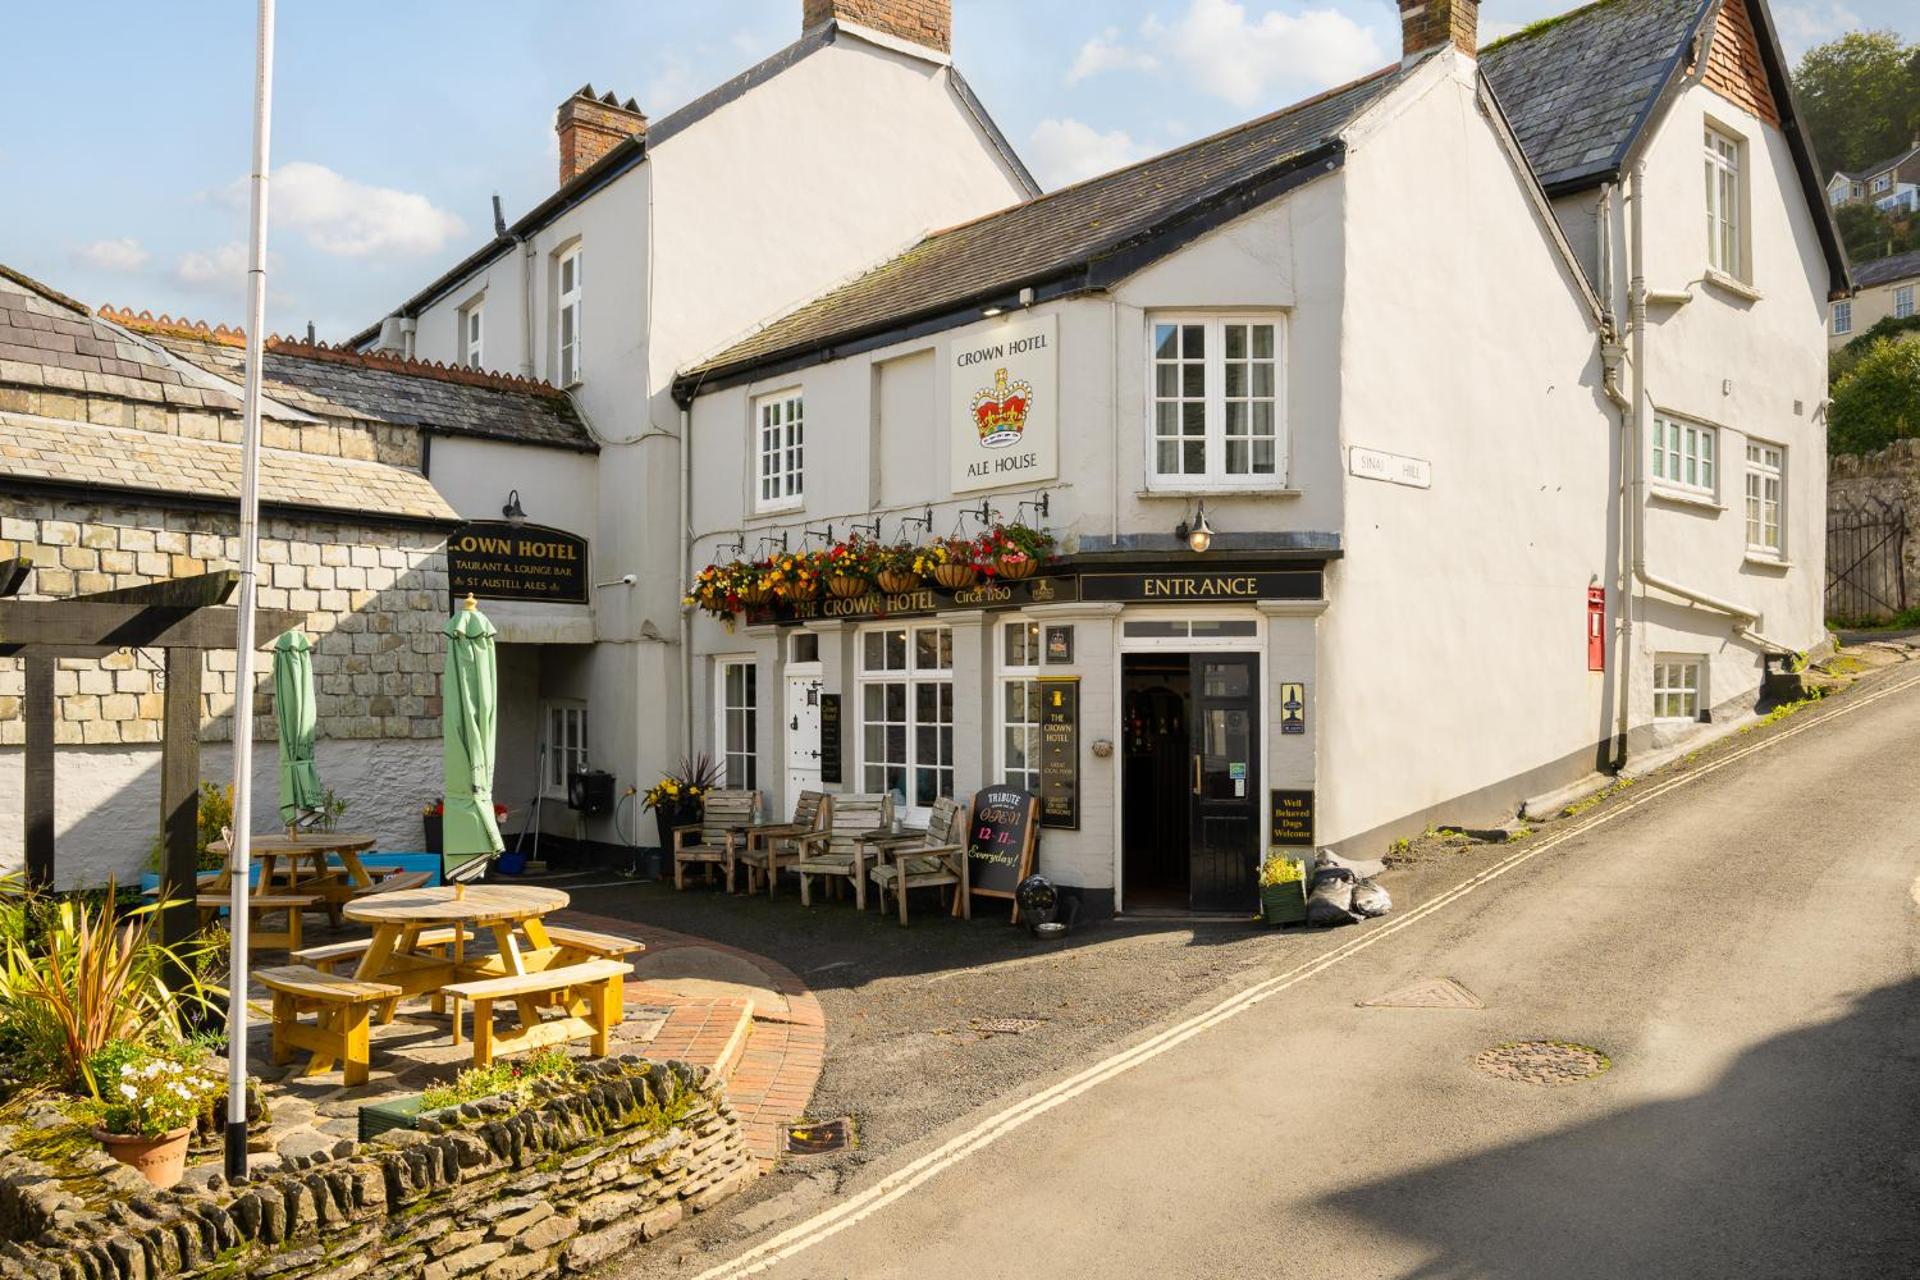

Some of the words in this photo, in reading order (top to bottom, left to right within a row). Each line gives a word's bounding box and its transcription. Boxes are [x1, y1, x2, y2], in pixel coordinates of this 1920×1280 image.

[957, 345, 1004, 367] CROWN
[1009, 334, 1048, 356] HOTEL
[967, 461, 990, 477] ALE
[995, 453, 1038, 473] HOUSE
[519, 541, 577, 560] HOTEL
[515, 565, 552, 576] LOUNGE
[554, 567, 572, 576] BAR
[467, 577, 479, 586] ST
[481, 578, 521, 589] AUSTELL
[524, 581, 547, 591] ALES
[1144, 577, 1258, 596] ENTRANCE
[823, 596, 880, 617] CROWN
[887, 591, 936, 611] HOTEL
[1051, 713, 1065, 723] THE
[1044, 724, 1072, 733] CROWN
[1046, 734, 1068, 742] HOTEL
[988, 792, 1021, 806] TRIBUTE
[1283, 799, 1302, 808] Well
[1275, 809, 1310, 817] Behaved
[1283, 819, 1303, 828] Dogs
[1274, 829, 1311, 838] Welcome
[968, 844, 1020, 868] Everyday!
